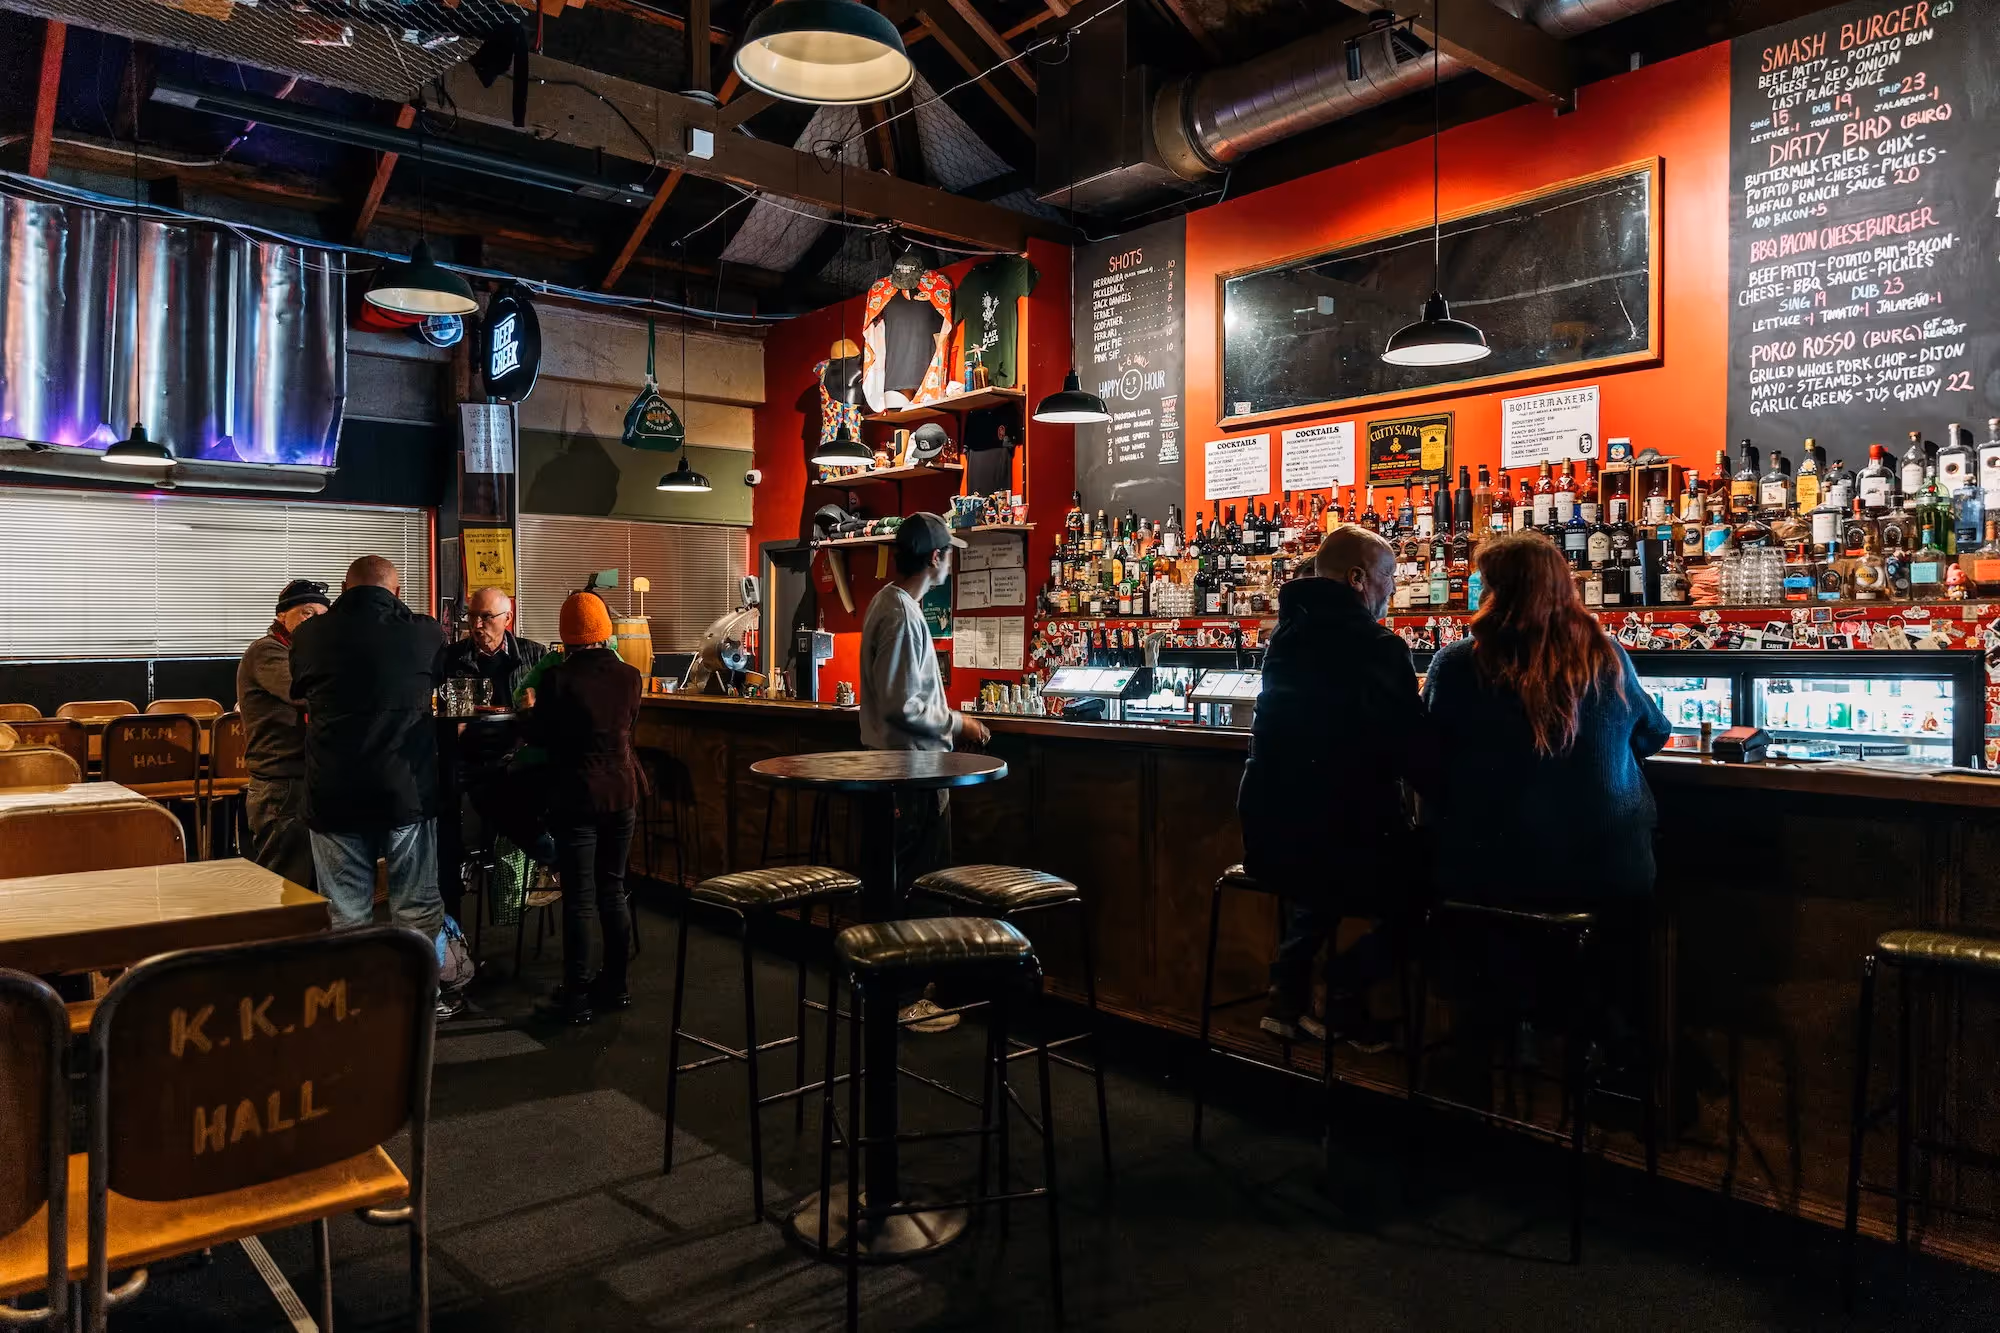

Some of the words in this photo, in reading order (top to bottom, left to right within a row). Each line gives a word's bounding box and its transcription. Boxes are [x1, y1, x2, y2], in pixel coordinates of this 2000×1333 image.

[1761, 31, 1827, 73] SMASH
[1839, 1, 1930, 51] BURGER
[1758, 69, 1788, 90] BEEF
[1792, 58, 1829, 79] PATTY
[1847, 38, 1900, 63] POTATO
[1905, 28, 1934, 48] BUN
[1767, 77, 1808, 99] CHEESE
[1824, 65, 1849, 83] RED
[1855, 50, 1901, 74] ONION
[1750, 118, 1771, 131] SING
[1772, 109, 1790, 129] 15
[1811, 102, 1832, 115] DUB
[1834, 93, 1853, 111] 19
[1878, 83, 1900, 98] TRIP
[1900, 71, 1927, 95] 23
[1772, 93, 1802, 111] LAST
[1805, 82, 1841, 103] PLACE
[1844, 68, 1885, 92] SAUCE
[1769, 128, 1831, 168] DIRTY
[1842, 115, 1892, 148] BIRD
[1744, 158, 1820, 191] BUTTERMILK
[1821, 146, 1870, 171] FRIED
[1876, 133, 1914, 156] CHIX
[1746, 183, 1789, 205] POTATO
[1791, 174, 1816, 194] BUN
[1824, 163, 1870, 184] CHEESE
[1880, 147, 1937, 175] PICKLES
[1746, 196, 1793, 219] BUFFALO
[1798, 184, 1840, 206] RANCH
[1845, 175, 1887, 195] SAUCE
[1893, 166, 1921, 185] 20
[1750, 240, 1779, 264] BBQ
[1780, 231, 1819, 258] BACON
[1819, 206, 1940, 252] CHEESEBURGER
[1752, 215, 1772, 230] ADD
[1773, 205, 1809, 227] BACON
[1108, 247, 1143, 273] SHOTS
[1748, 266, 1780, 288] BEEF
[1781, 260, 1818, 281] PATTY
[1827, 250, 1873, 272] POTATO
[1907, 233, 1953, 256] BACON
[1092, 282, 1125, 300] PICKLEBACK
[1738, 283, 1785, 307] CHEESE
[1792, 276, 1824, 296] BBQ
[1826, 265, 1869, 287] SAUCE
[1877, 252, 1935, 277] PICKLES
[1778, 296, 1811, 313] SING
[1814, 290, 1827, 307] 19
[1851, 283, 1880, 301] DUB
[1883, 276, 1905, 296] 23
[492, 318, 515, 353] DEEP
[1092, 315, 1124, 332] GODFATHER
[1093, 328, 1118, 342] FERRARI
[1752, 313, 1800, 333] LETTUCE
[491, 339, 519, 377] CREEK
[1093, 340, 1111, 354] APPLE
[1111, 336, 1123, 350] PIE
[1093, 353, 1108, 365] PINK
[1749, 364, 1795, 385] GRILLED
[1796, 360, 1835, 379] WHOLE
[1836, 355, 1873, 374] PORK
[1874, 351, 1908, 369] CHOP
[1919, 342, 1966, 364] DIJON
[1750, 341, 1797, 369] PORCO
[1802, 330, 1857, 360] ROSSO
[1862, 323, 1924, 349] (BURG)
[1098, 378, 1121, 400] HAPPY
[1144, 369, 1166, 392] HOUR
[1749, 397, 1799, 417] GARLIC
[1801, 390, 1854, 411] GREENS
[1865, 385, 1891, 403] JUS
[1892, 378, 1942, 402] GRAVY
[1945, 370, 1975, 393] 22
[1751, 382, 1786, 400] MAYO
[1796, 373, 1863, 394] STEAMED
[1875, 364, 1936, 386] SAUTEED
[1509, 392, 1594, 413] BOILERMAKERS
[1217, 438, 1257, 450] COCKTAILS
[1295, 425, 1340, 439] COCKTAILS
[1370, 424, 1396, 442] CUTTY
[1394, 424, 1420, 438] SARK
[132, 751, 176, 770] HALL
[168, 978, 362, 1058] K.K.M.
[193, 1079, 330, 1156] HALL
